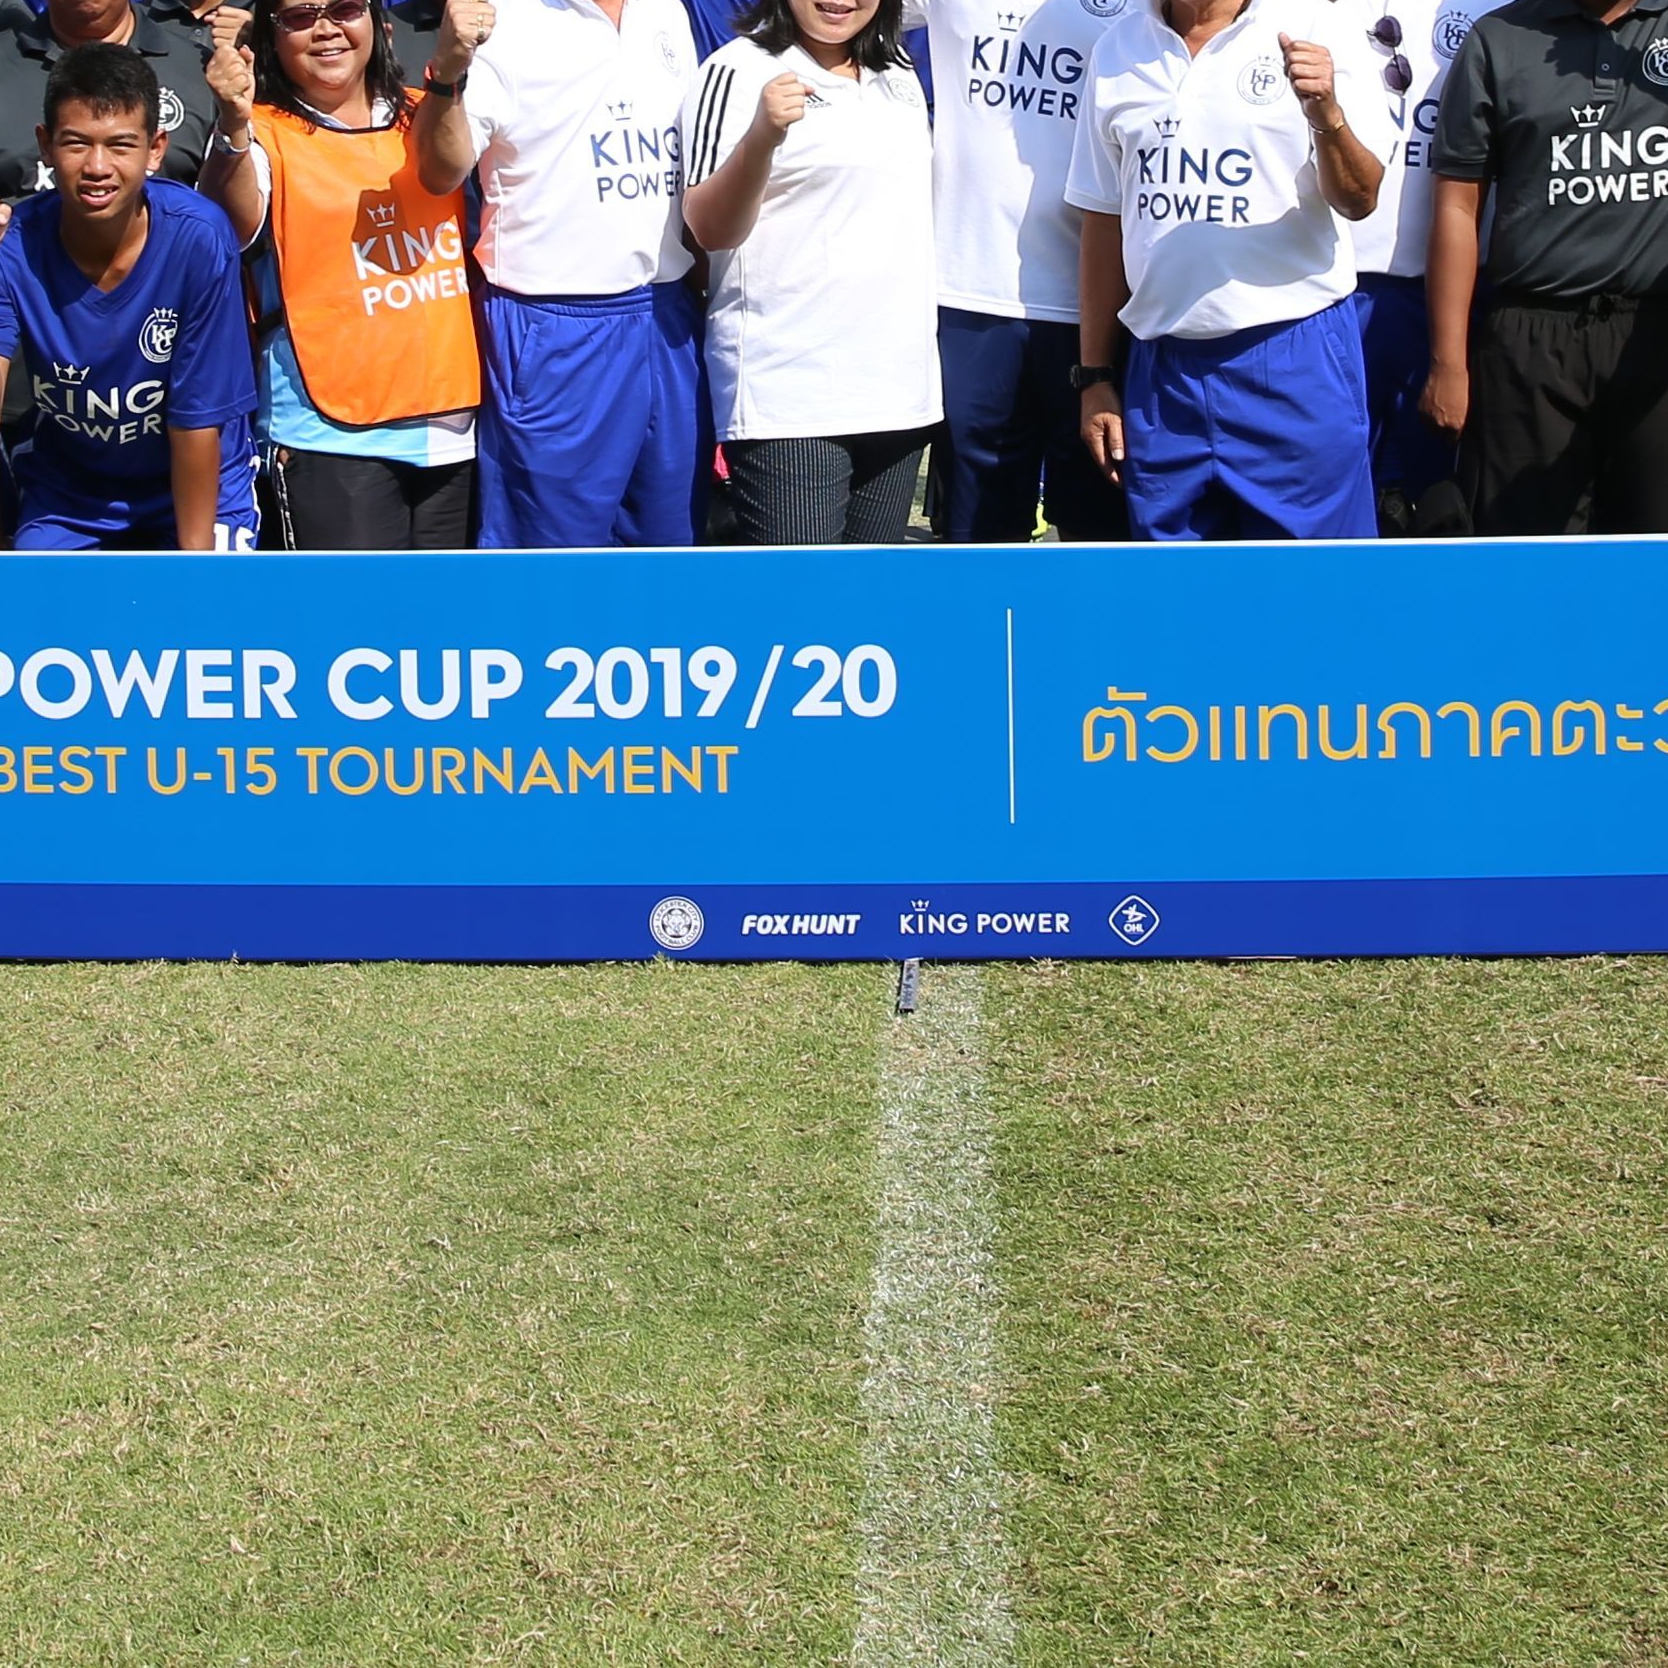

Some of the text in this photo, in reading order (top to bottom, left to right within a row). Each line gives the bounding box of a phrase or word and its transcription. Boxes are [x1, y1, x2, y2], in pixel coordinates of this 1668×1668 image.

[971, 36, 1084, 85] KING
[968, 77, 1077, 120] POWER
[590, 126, 679, 169] KING
[1137, 145, 1253, 187] KING
[1137, 192, 1250, 225] POWER
[350, 221, 463, 281] KING
[361, 268, 471, 317] POWER
[33, 374, 165, 420] KING
[328, 648, 523, 720] CUP
[545, 644, 897, 729] 2019/20
[148, 747, 277, 796] U-15
[296, 745, 739, 796] TOURNAMENT
[900, 913, 1070, 934] KING POWER
